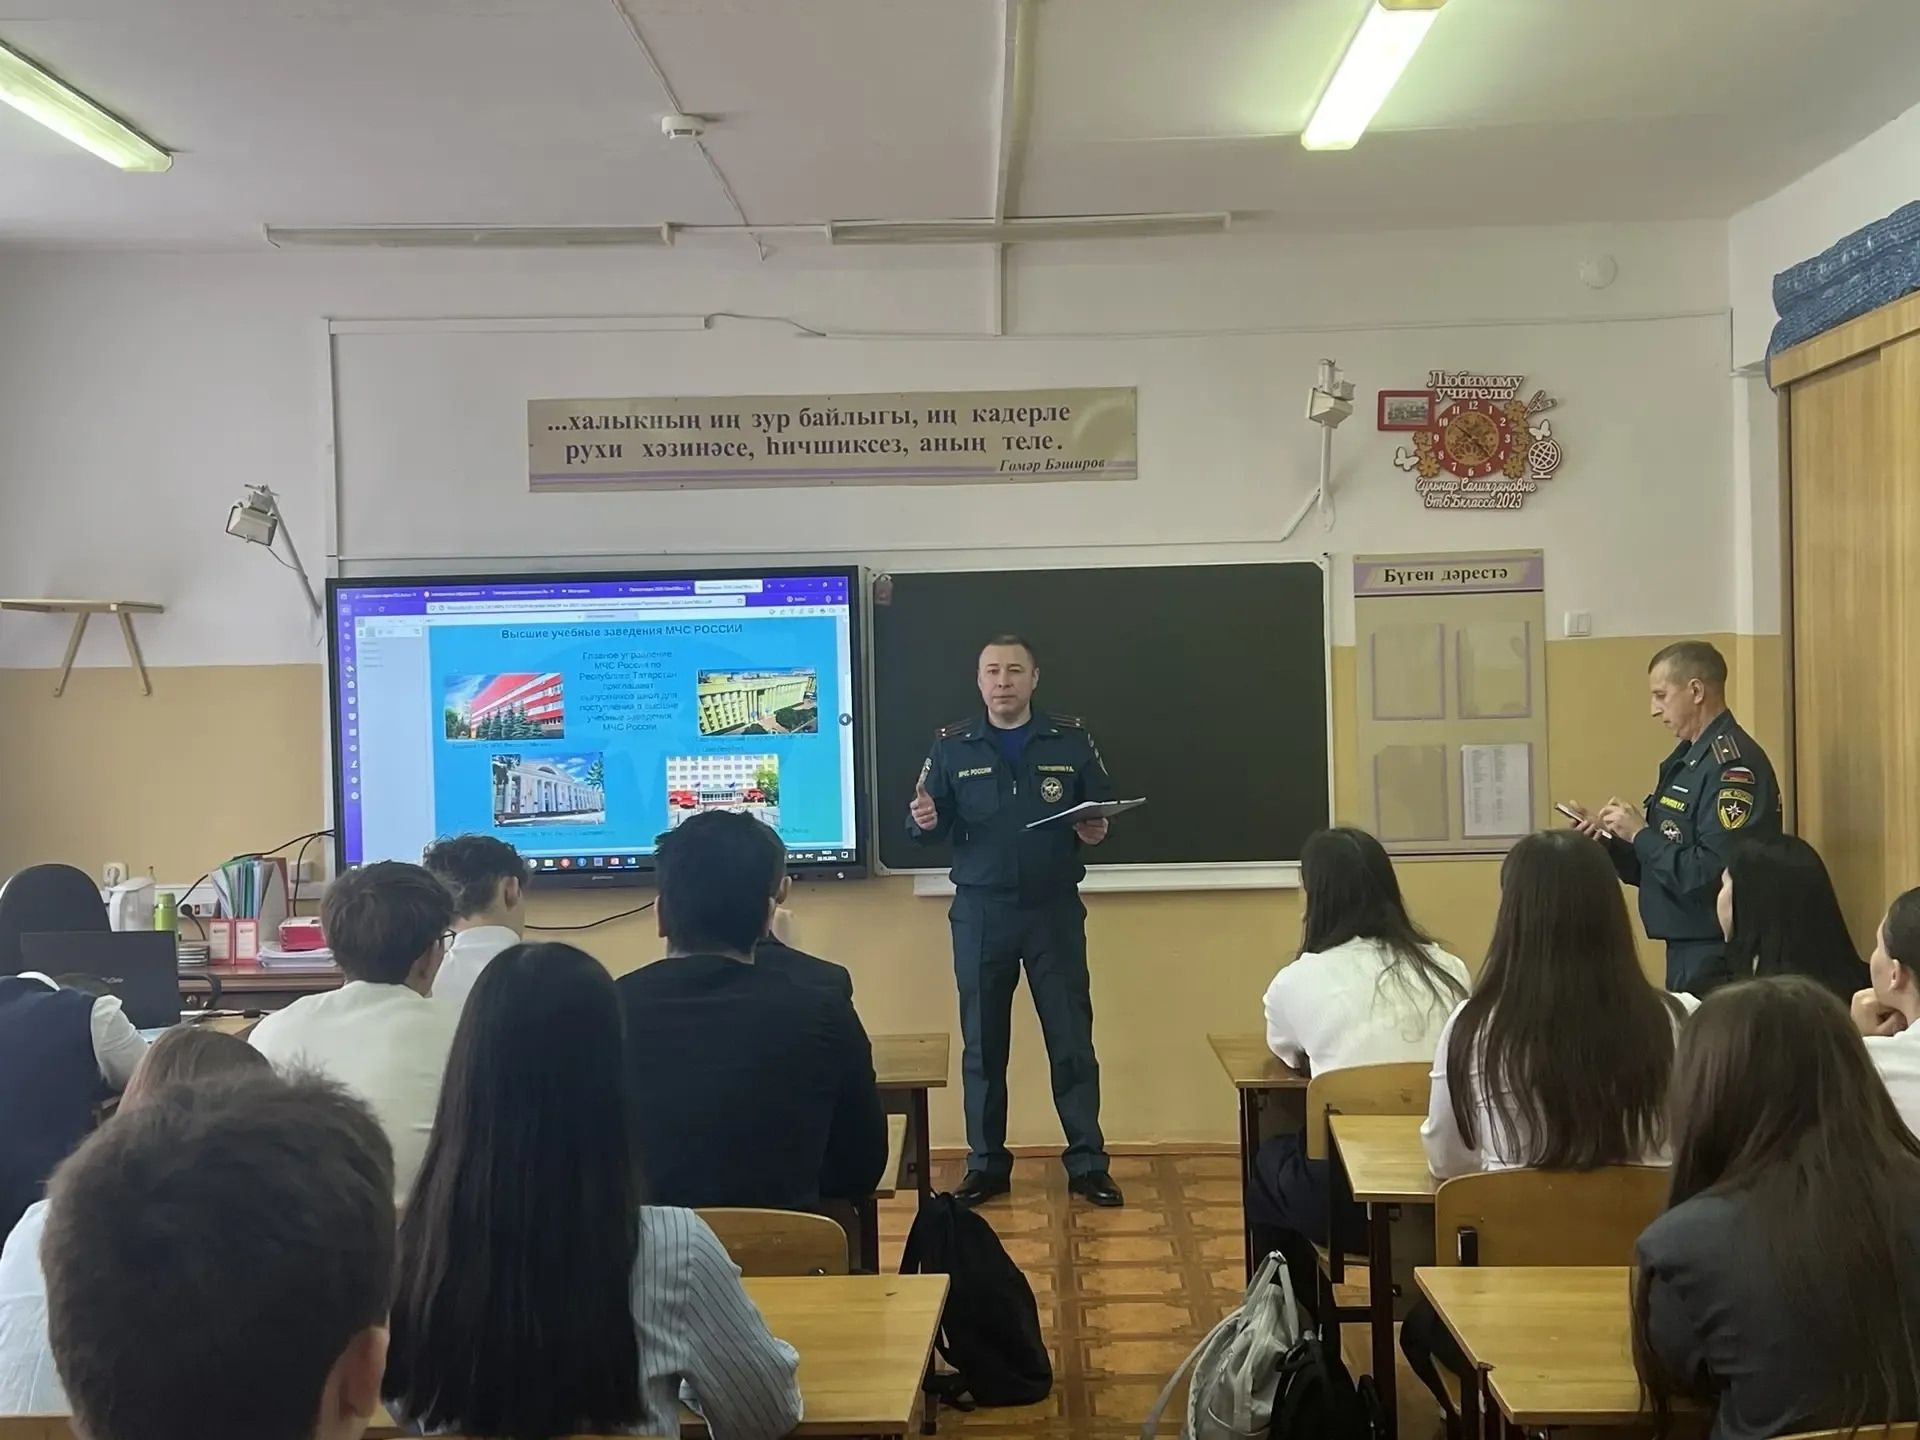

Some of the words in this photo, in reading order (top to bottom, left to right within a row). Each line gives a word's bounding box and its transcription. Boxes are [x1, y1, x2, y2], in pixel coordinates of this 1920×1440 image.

[1427, 371, 1523, 389] Любимому
[1436, 387, 1514, 402] учителю
[1468, 401, 1479, 410] 12
[1488, 406, 1493, 414] 1
[1452, 406, 1461, 415] 11
[548, 413, 701, 433] ...халыкның
[711, 413, 741, 431] иң
[752, 411, 790, 434] зур
[800, 407, 919, 428] байлыгы,
[927, 409, 956, 426] иң
[972, 405, 1071, 428] кадерле
[1438, 418, 1449, 427] 10
[1500, 418, 1506, 427] 2
[1433, 434, 1440, 443] 9
[1504, 434, 1511, 443] 3
[565, 442, 623, 464] рухи
[642, 441, 754, 461] хәзинәсе,
[766, 436, 909, 457] һичшиксез,
[920, 436, 986, 454] аның
[1002, 433, 1063, 452] теле.
[1438, 451, 1444, 460] 8
[1499, 451, 1505, 460] 4
[1045, 458, 1105, 472] Бәширов
[1451, 462, 1457, 471] 7
[1485, 463, 1492, 472] 5
[1468, 467, 1474, 476] 6
[1416, 477, 1460, 496] Гульнар
[1496, 492, 1522, 508] 2023
[1384, 568, 1434, 585] Бүген
[1441, 567, 1508, 583] дәрестә
[501, 629, 549, 639] Высшие
[551, 628, 600, 640] учебные
[603, 626, 662, 638] заведения
[665, 624, 691, 635] МЧС
[694, 623, 743, 634] РОССИИ
